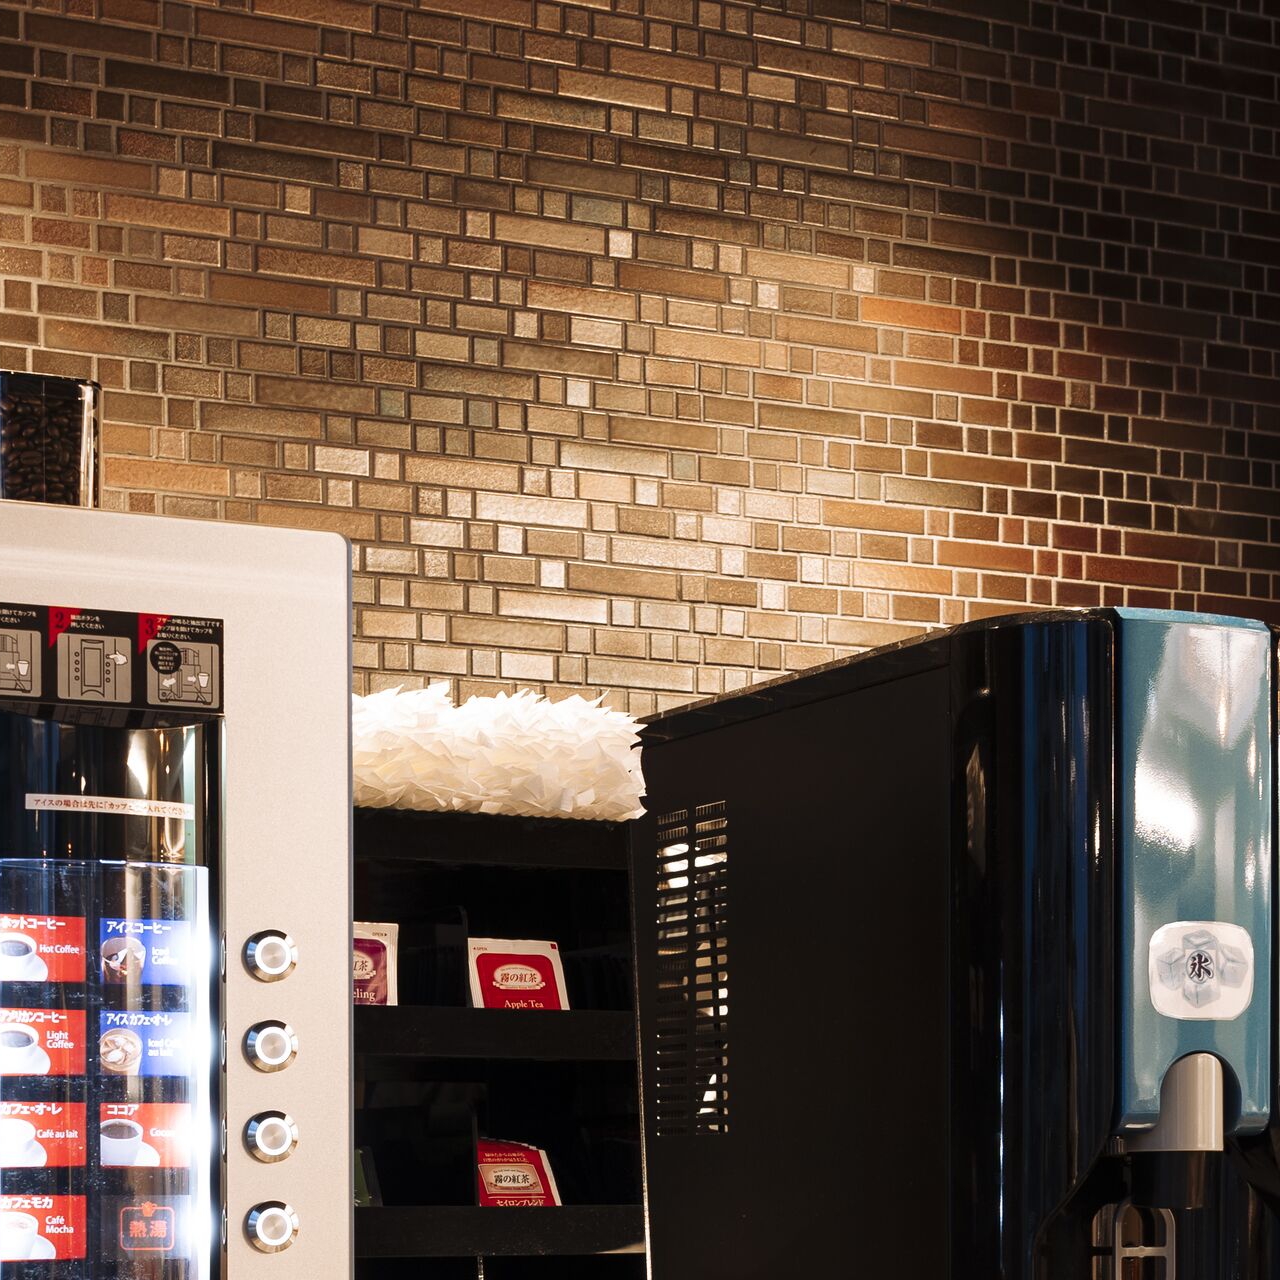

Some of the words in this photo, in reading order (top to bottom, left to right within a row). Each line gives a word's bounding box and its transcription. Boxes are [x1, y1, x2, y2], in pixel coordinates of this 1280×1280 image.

[0, 916, 66, 930] ホットコーヒー
[106, 920, 172, 934] アイスコーヒー
[39, 944, 54, 953] Hot
[55, 944, 80, 954] Coffee
[1189, 953, 1214, 981] 氷
[500, 972, 537, 983] 霧の紅茶
[504, 999, 528, 1009] Apple
[529, 999, 544, 1008] Tea
[46, 1030, 69, 1042] Light
[46, 1038, 74, 1049] Coffee
[106, 1104, 139, 1115] ココア
[36, 1128, 54, 1138] Café
[55, 1130, 65, 1138] au
[66, 1129, 78, 1138] lait
[494, 1174, 530, 1184] 霧の紅茶
[1, 1196, 53, 1209] カフェモカ
[45, 1214, 65, 1225] Café
[45, 1224, 74, 1234] Mocha
[129, 1219, 168, 1238] 熱湯
